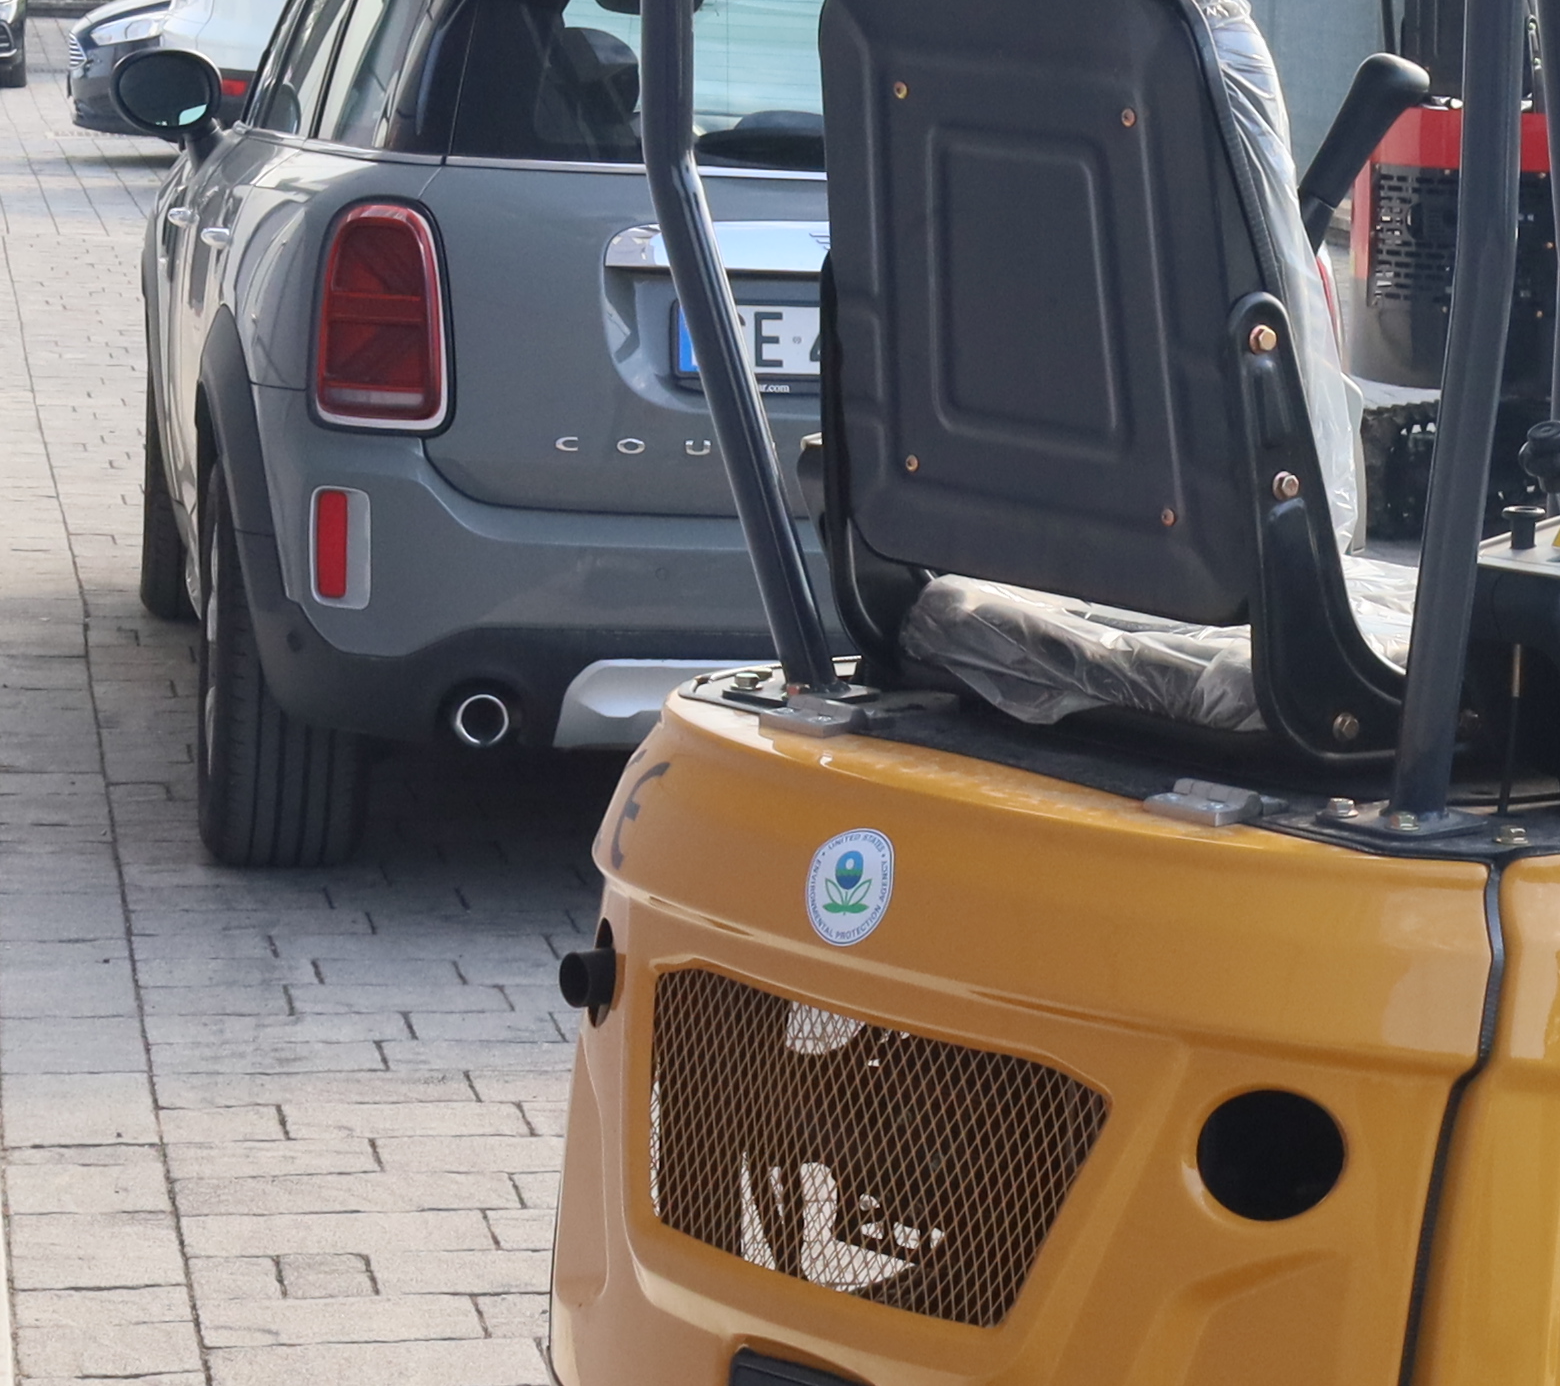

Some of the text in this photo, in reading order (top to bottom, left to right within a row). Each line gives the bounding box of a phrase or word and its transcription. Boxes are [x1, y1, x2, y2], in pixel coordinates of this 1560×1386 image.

[555, 435, 776, 456] COU
[828, 833, 886, 853] UNITED STATES
[809, 858, 888, 940] ENVIRONMENTAL PROTECTION AGENCY
